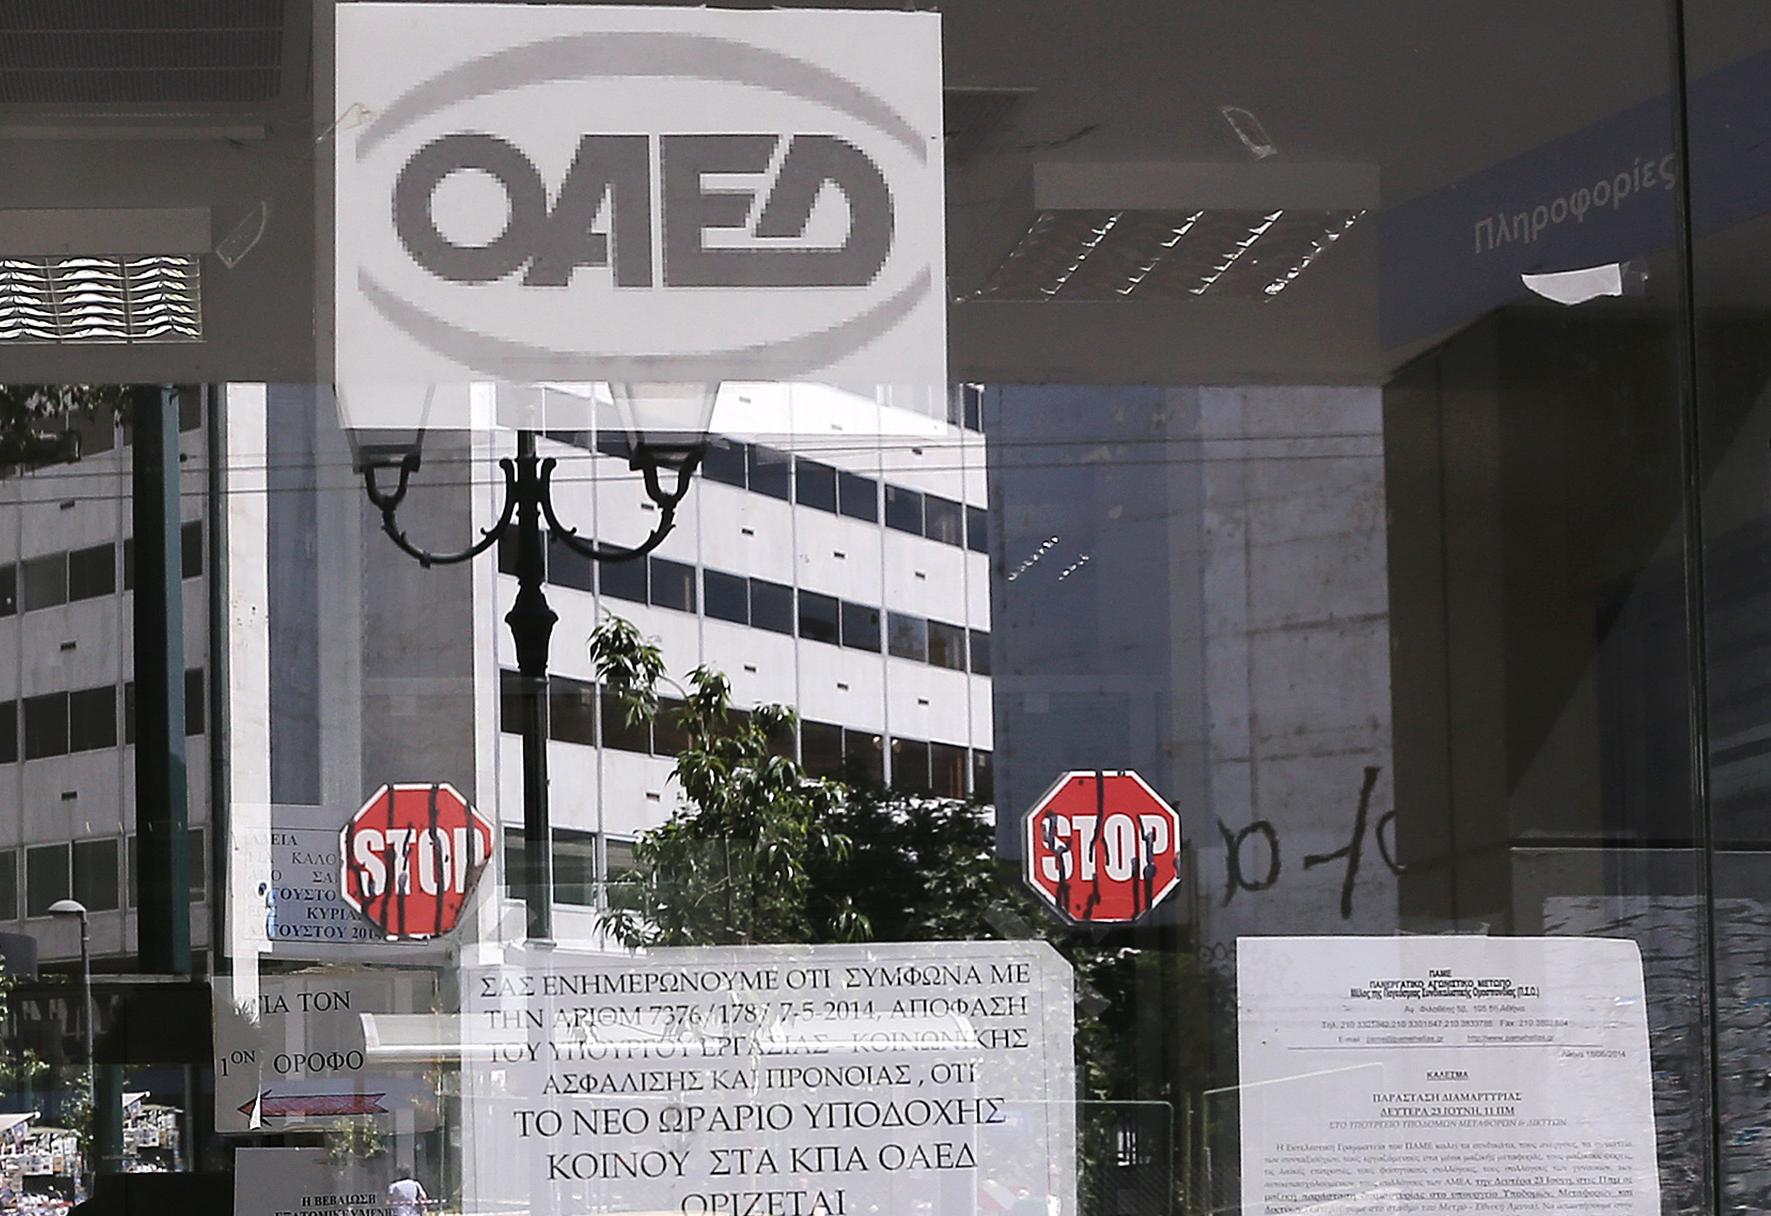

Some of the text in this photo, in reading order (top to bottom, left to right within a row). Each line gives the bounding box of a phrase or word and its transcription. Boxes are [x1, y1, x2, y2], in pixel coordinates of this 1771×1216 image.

[1474, 152, 1677, 255] Πληροφορίες
[1040, 812, 1169, 884] STOP
[481, 963, 1030, 998] ΣΑΣ ΕΝΗΜΕΡΩΝΟΥΜΕ ΟΤΙ ΣΥΜΦΩΝΑ ΜΕ
[297, 991, 351, 1013] ΤΟΝ
[485, 1009, 543, 1030] ΤΗΝ
[553, 1005, 642, 1028] ΑΡΙΘΜ
[890, 996, 1028, 1019] ΑΠΟΦΑΣΗ
[273, 1050, 365, 1074] ΟΡΟΦΟ
[486, 1041, 541, 1063] ΤΟΥ
[700, 1034, 830, 1058] ΕΡΓΑΣΙΑΣ
[542, 1070, 704, 1095] ΑΣΦΑΛΙΣΗΣ
[712, 1068, 757, 1091] ΚΑΙ
[766, 1064, 912, 1088] ΠΡΟΝΟΙΑΣ
[930, 1063, 978, 1084] ΟΤΙ
[1372, 1091, 1523, 1103] ΠΑΡΑΣΤΑΣΗ ΔΙΑΜΑΡΤΥΡΙΑΣ
[1380, 1107, 1429, 1117] ΔΕΥΤΕΡΑ
[513, 1097, 1008, 1137] ΤΟ ΝΕΟ ΩΡΑΡΙΟ ΥΠΟΔΟΧΗΣ
[546, 1142, 979, 1180] ΚΟΙΝΟΥ ΣΤΑ ΚΠΑ ΟΑΕΔ
[301, 1194, 376, 1208] Η ΒΕΒΑΙΩΣΗ
